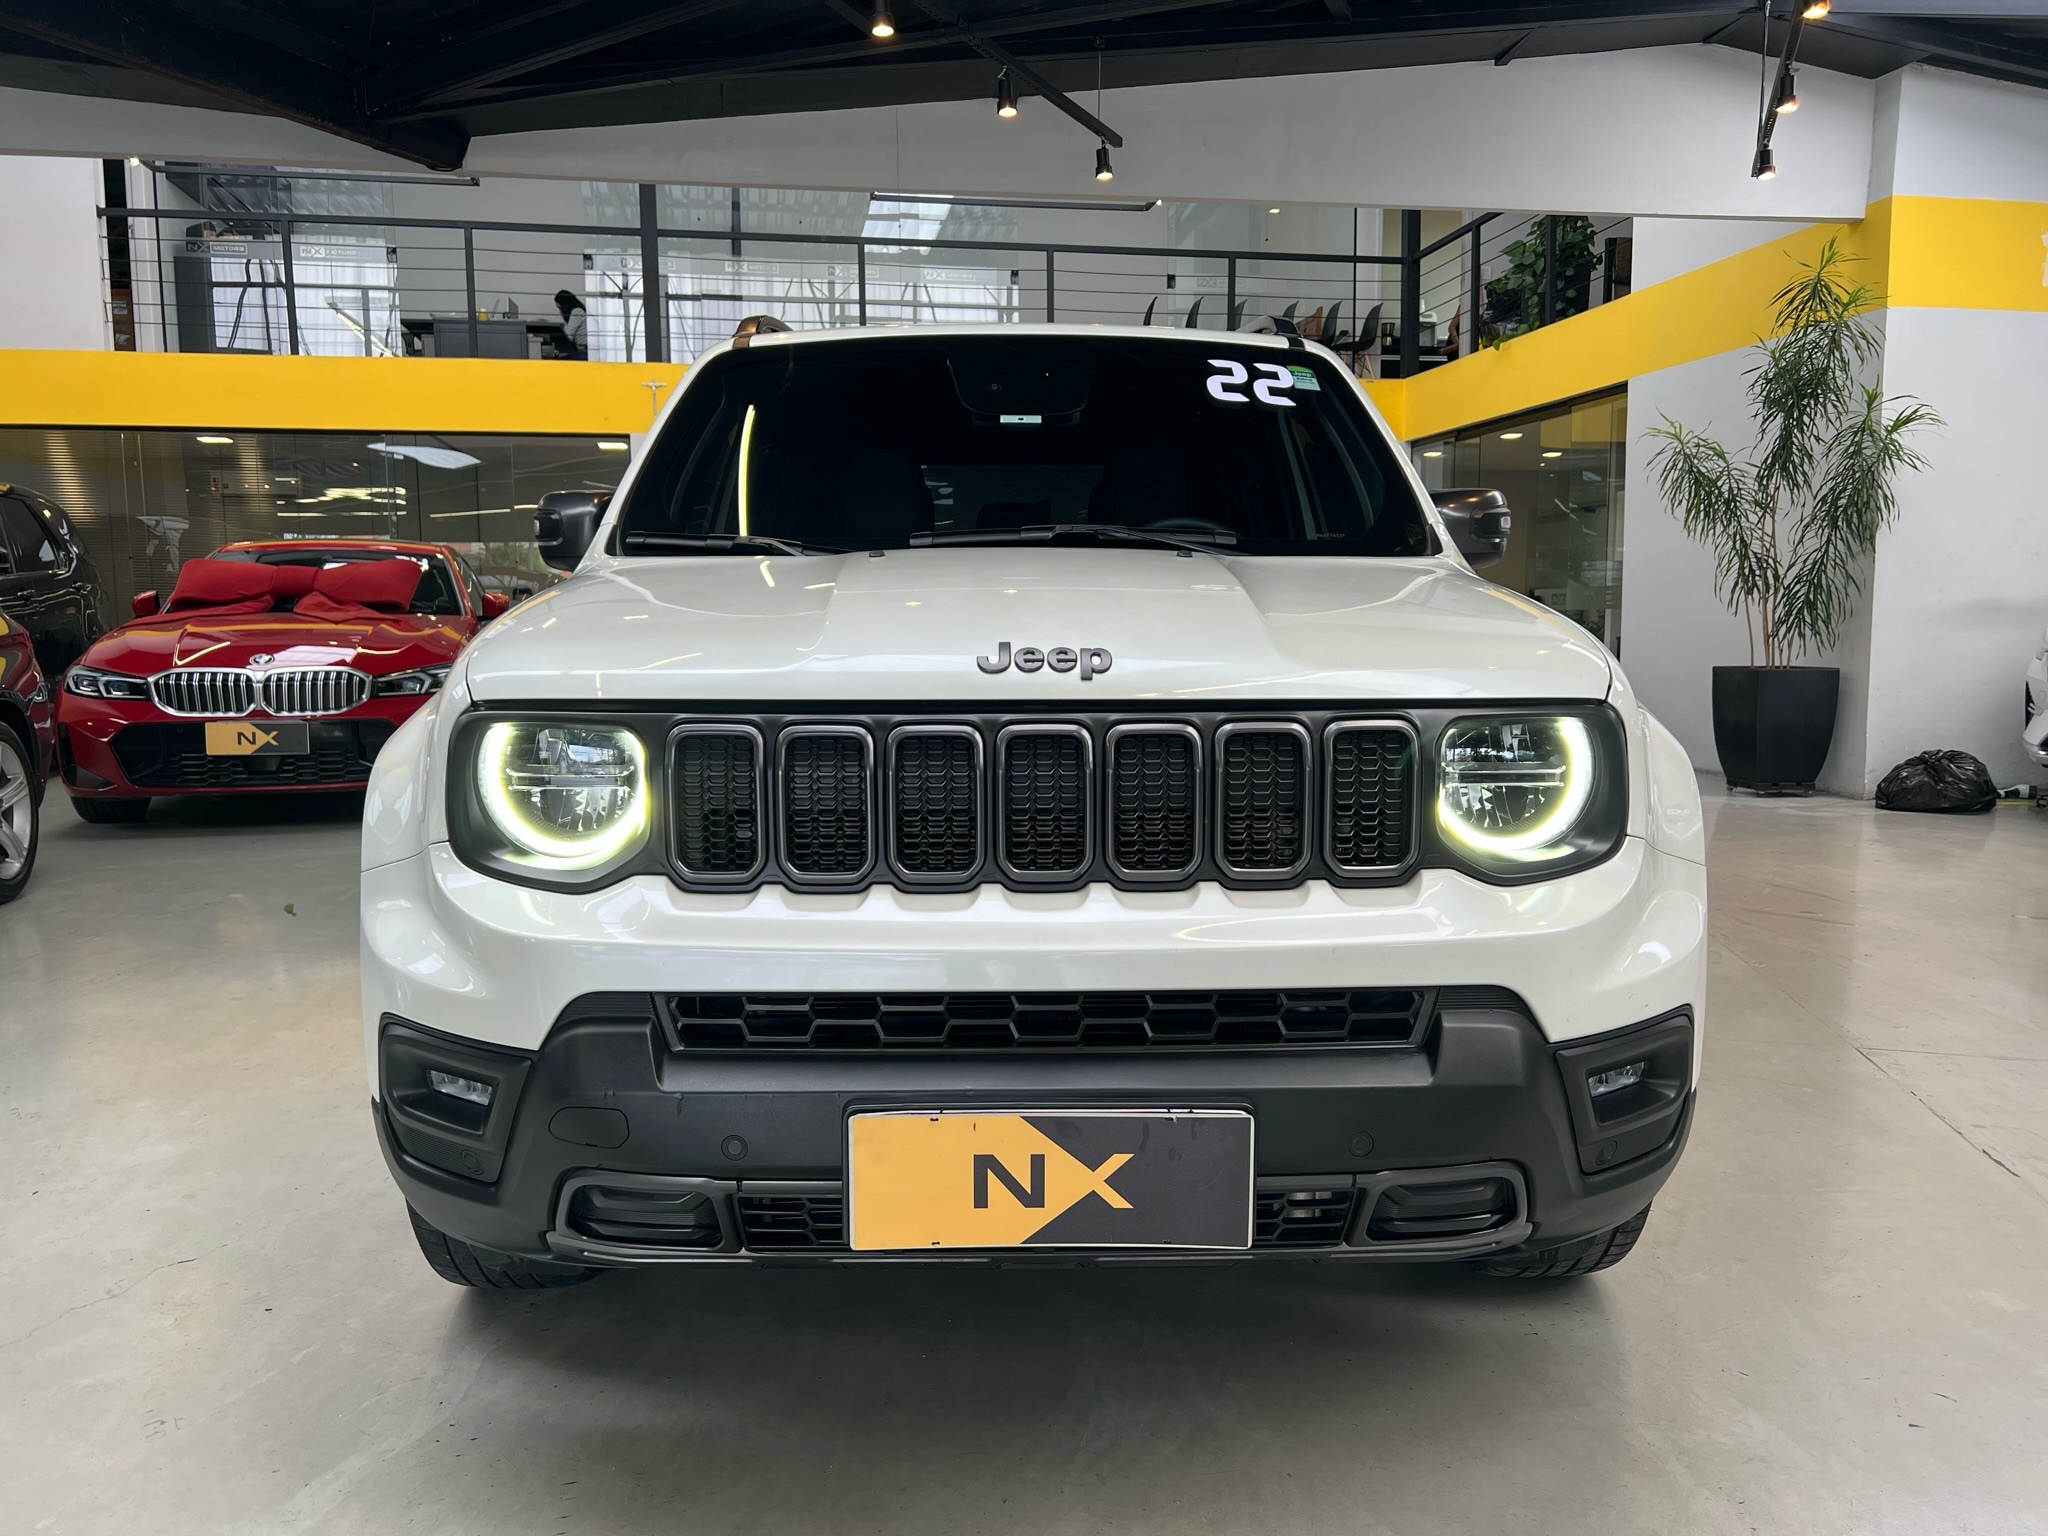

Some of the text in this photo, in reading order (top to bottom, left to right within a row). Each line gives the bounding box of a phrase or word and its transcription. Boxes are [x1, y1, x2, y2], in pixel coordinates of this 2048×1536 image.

[187, 241, 209, 253] NX
[302, 246, 323, 258] NX
[1206, 359, 1297, 406] 22
[976, 641, 1113, 681] Jeep
[237, 730, 279, 746] NX
[973, 1153, 1136, 1209] NX
